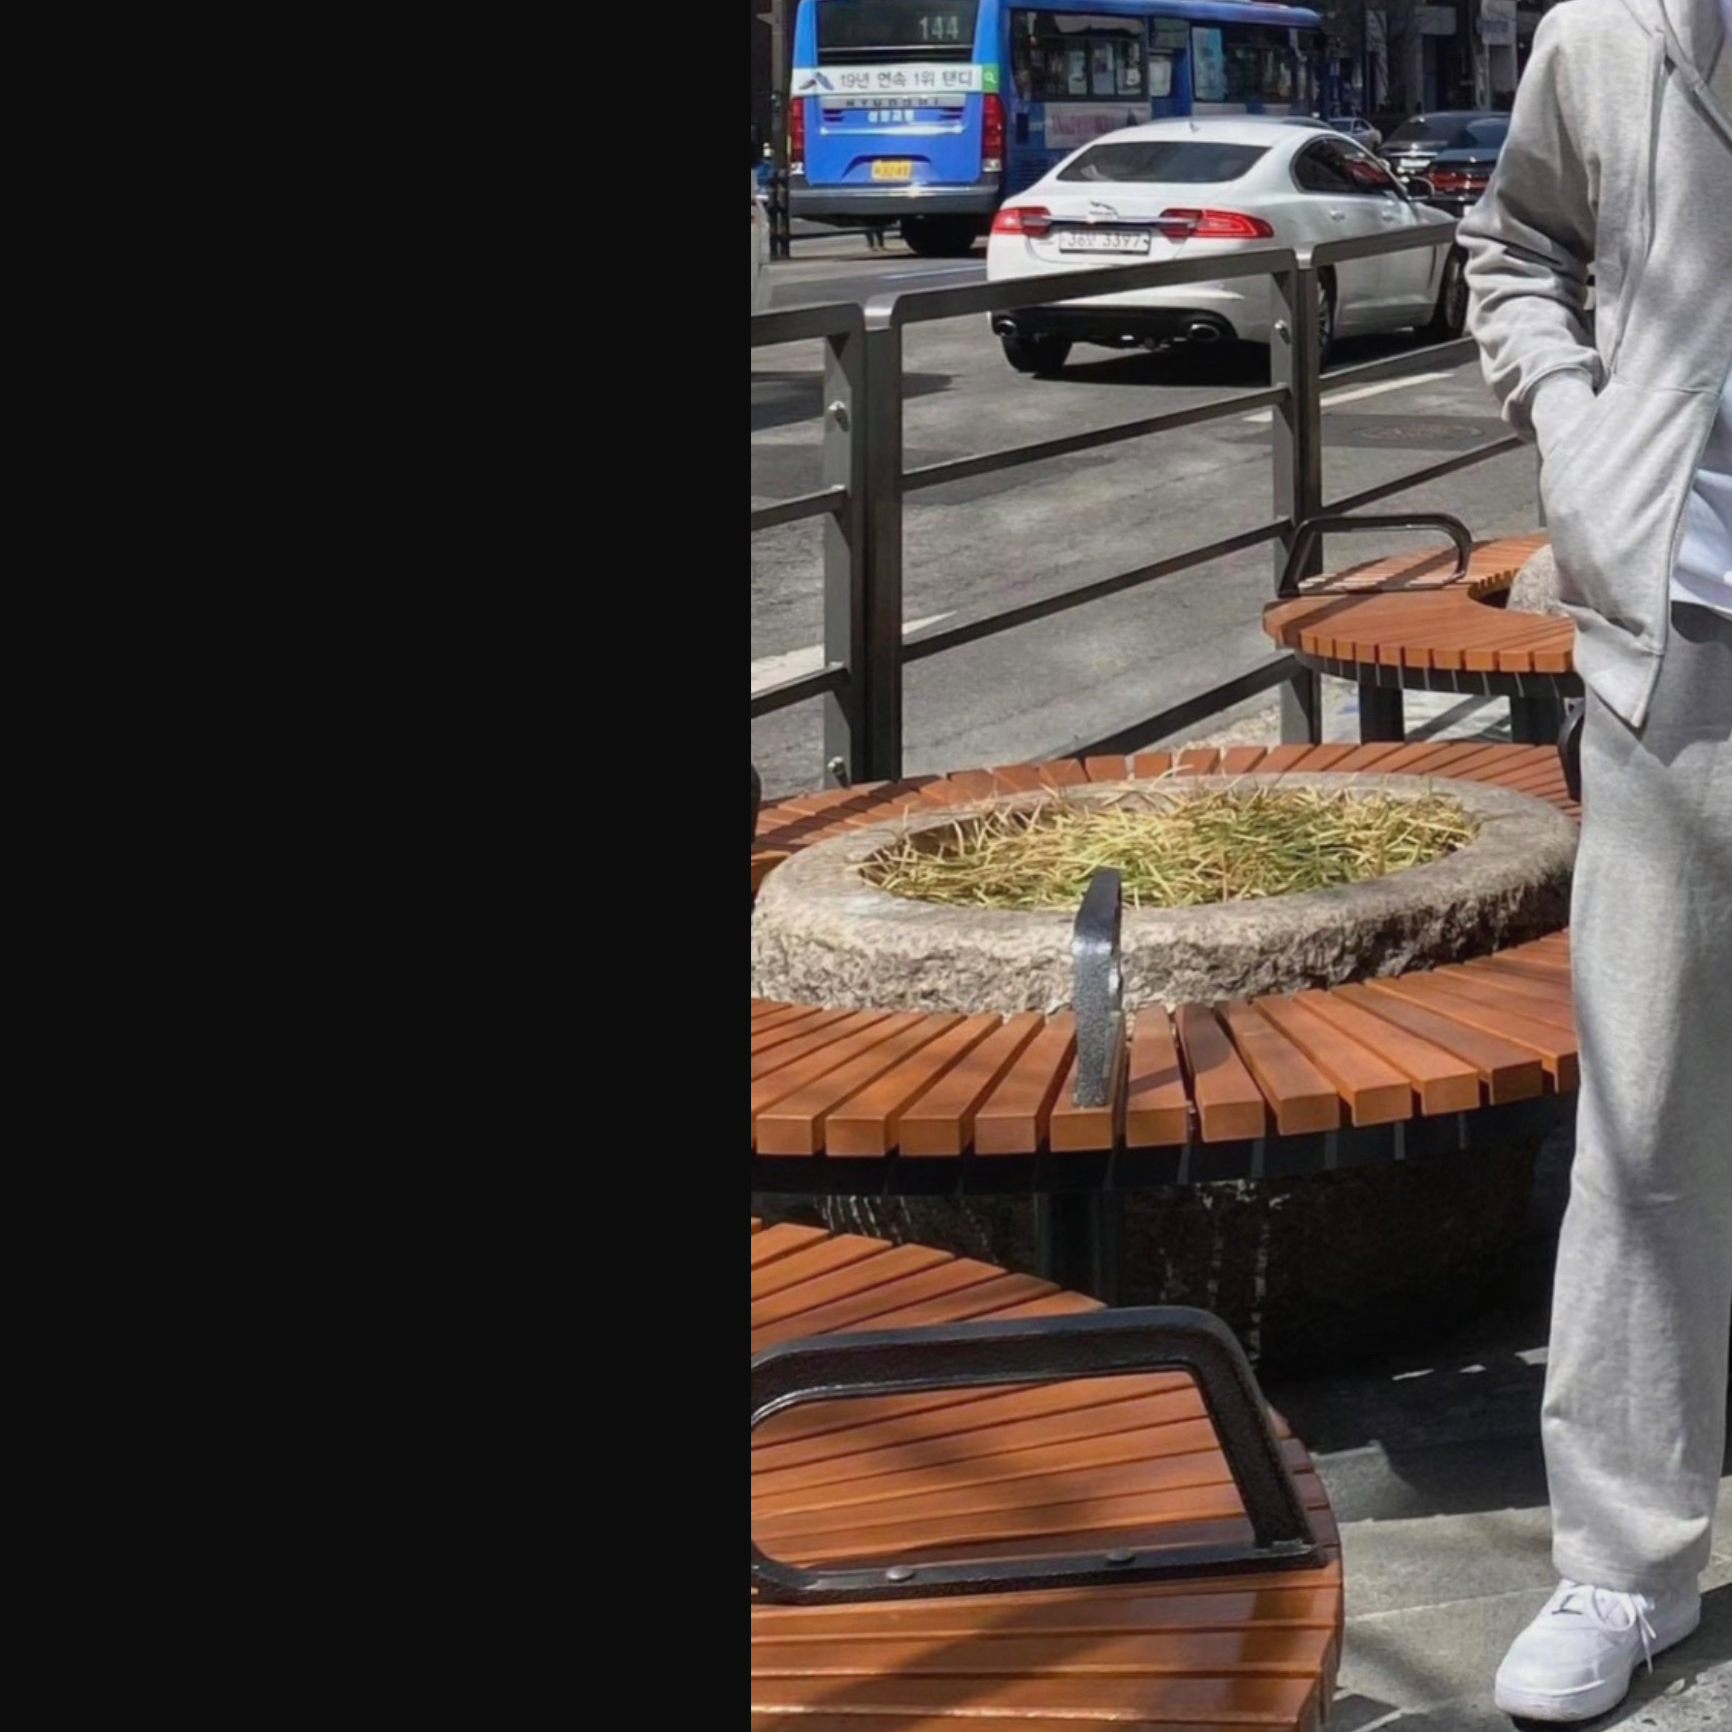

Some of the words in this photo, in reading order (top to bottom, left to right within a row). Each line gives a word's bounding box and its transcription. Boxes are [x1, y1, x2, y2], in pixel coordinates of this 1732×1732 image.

[919, 16, 960, 41] 144
[840, 71, 870, 90] 19년
[877, 70, 907, 89] 연속
[913, 70, 936, 88] 1위
